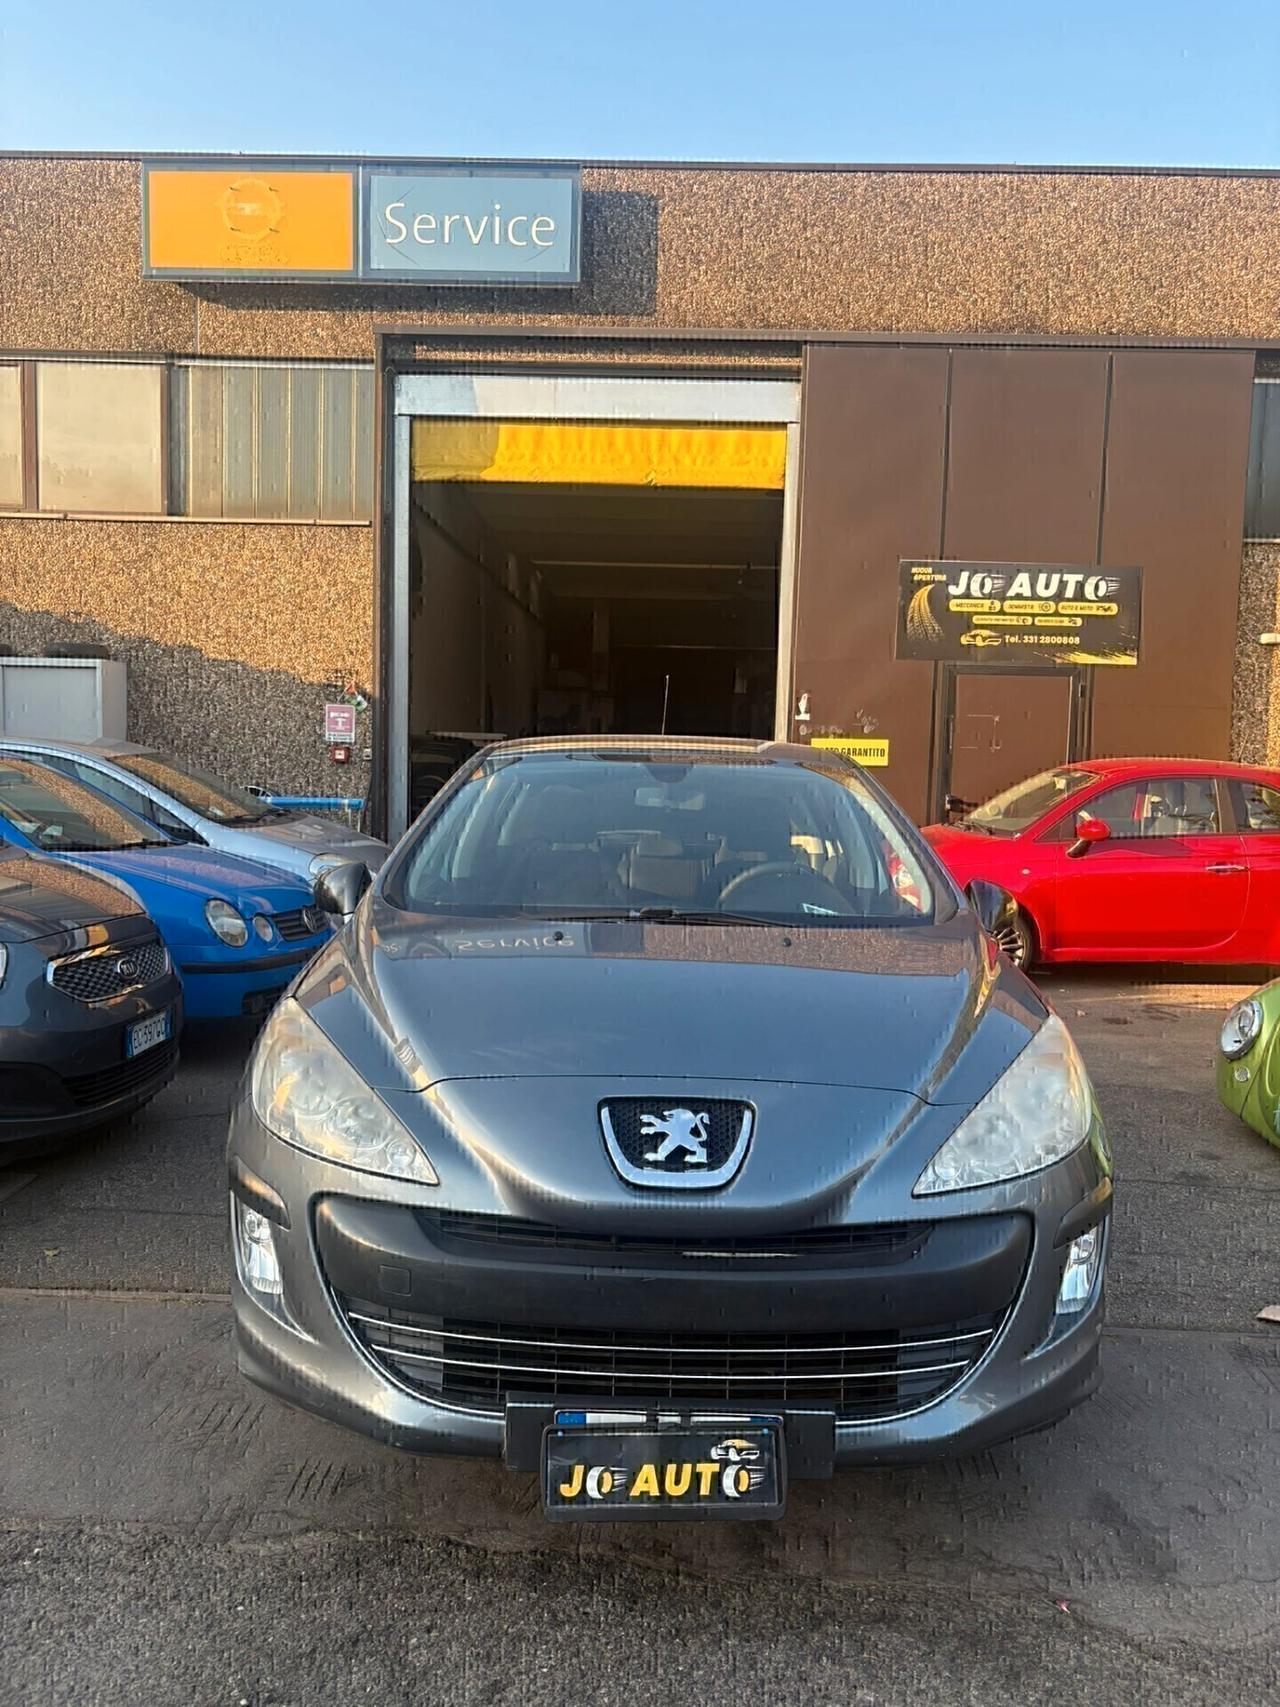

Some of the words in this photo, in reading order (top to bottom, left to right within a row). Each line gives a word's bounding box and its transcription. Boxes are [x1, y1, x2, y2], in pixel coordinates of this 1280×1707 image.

[384, 202, 556, 247] Service
[948, 571, 993, 598] JO
[1006, 572, 1108, 600] AUTO
[1004, 634, 1021, 643] Tel.
[1024, 635, 1037, 643] 331
[840, 747, 885, 757] GARANTITO
[559, 1464, 613, 1499] JO
[629, 1462, 751, 1499] AUTO
